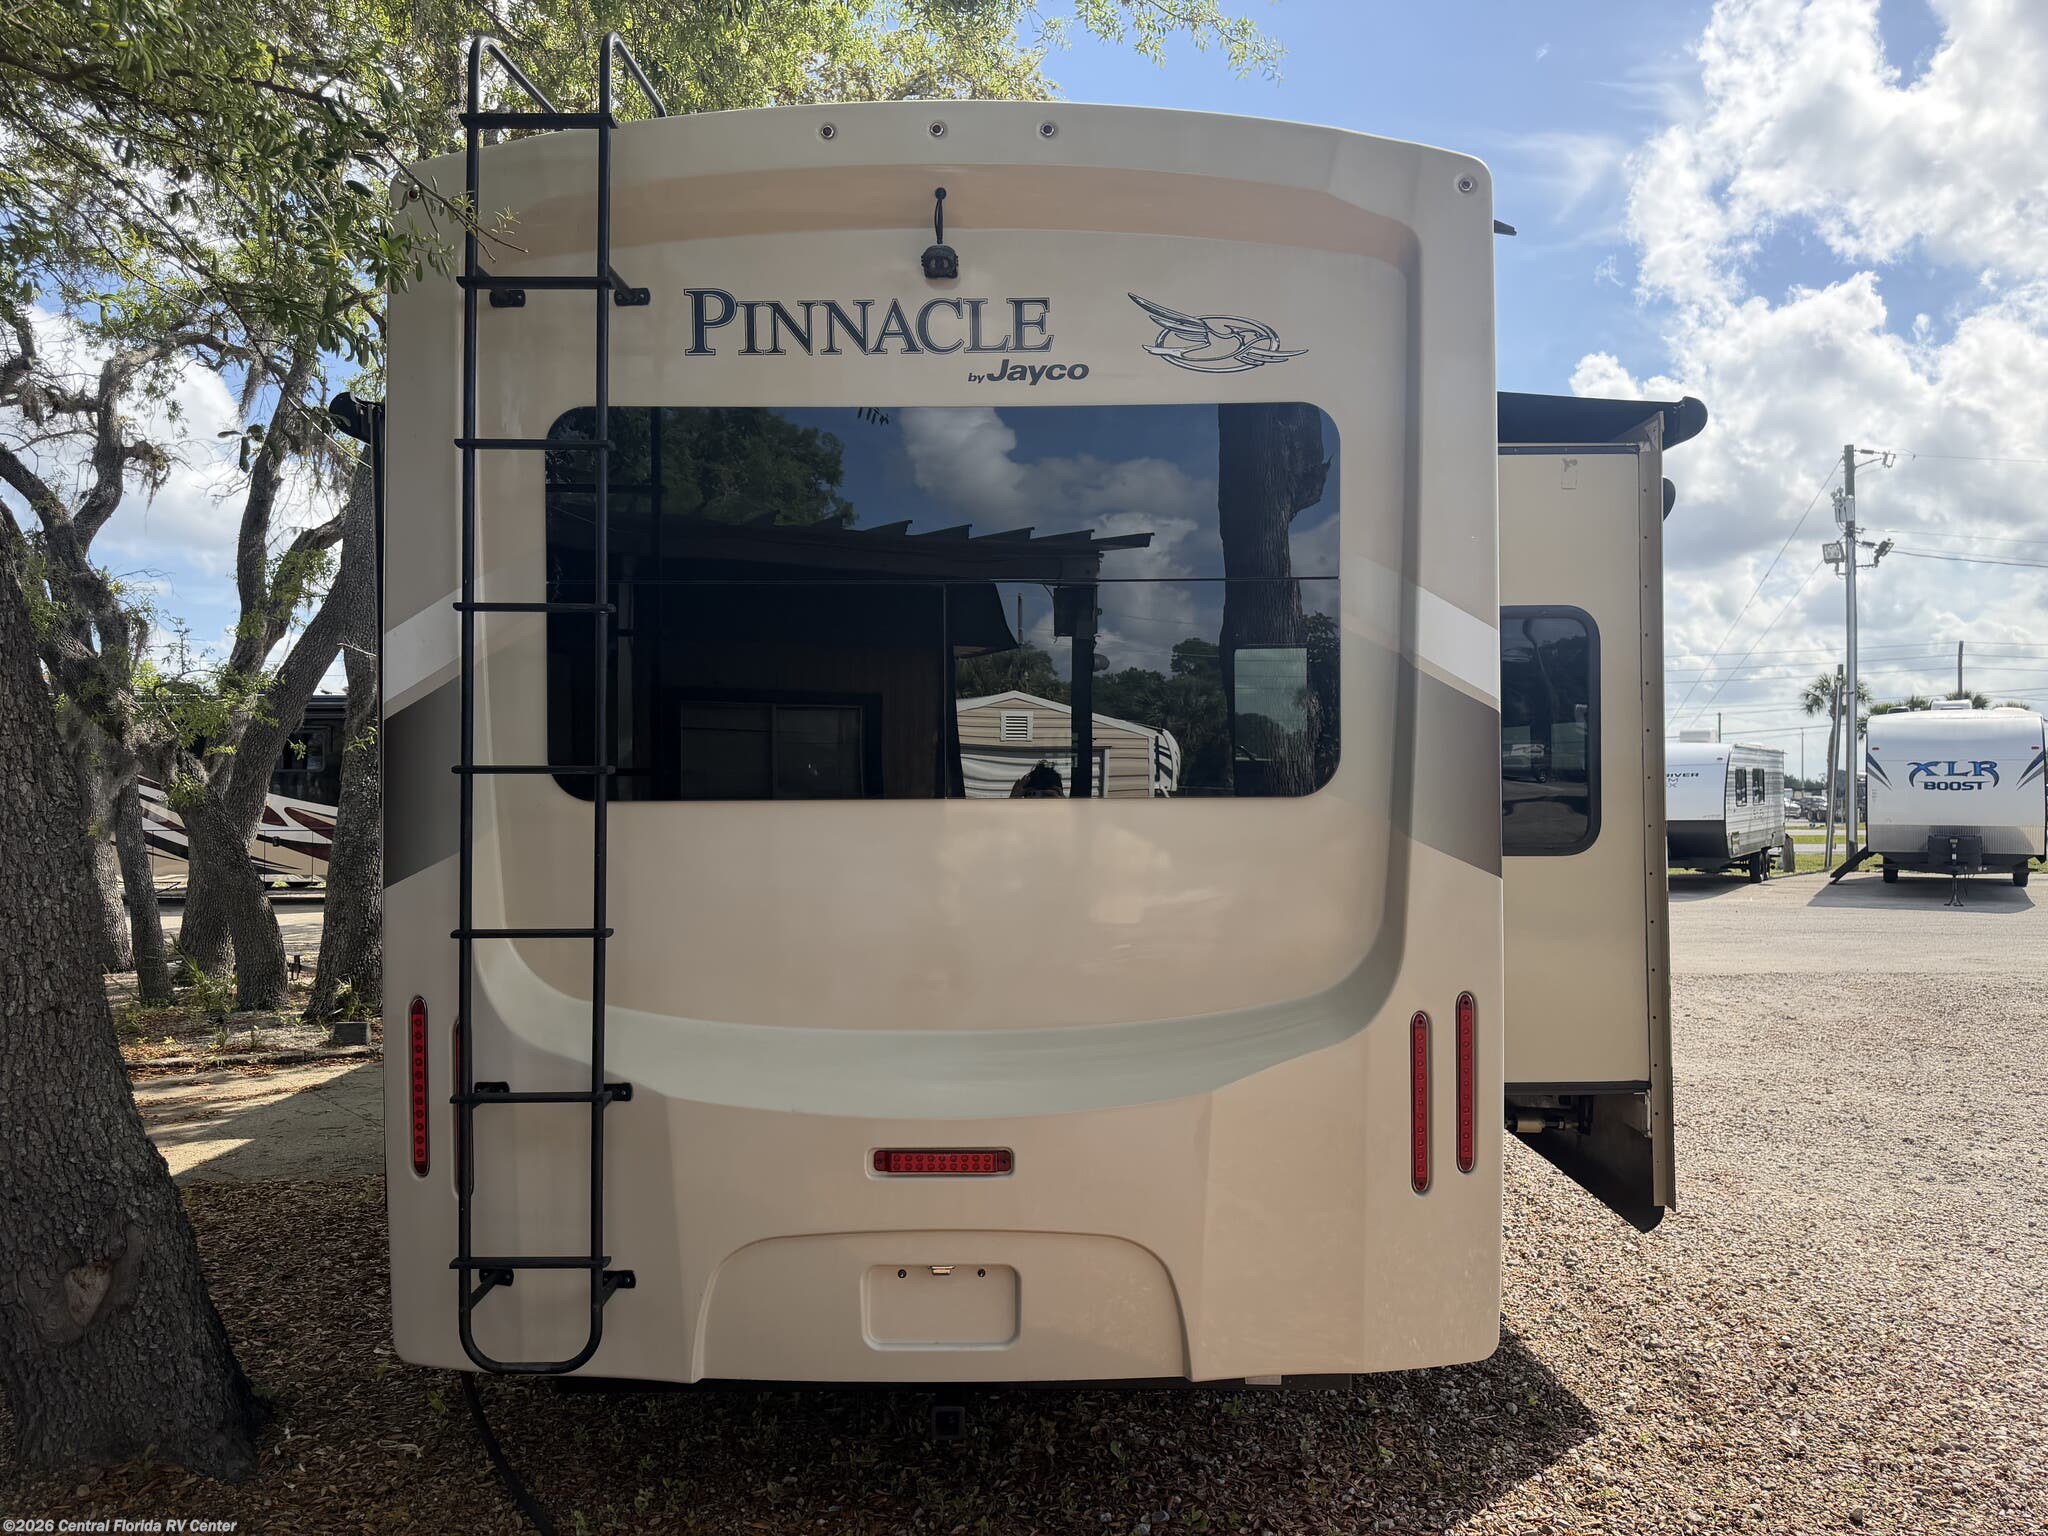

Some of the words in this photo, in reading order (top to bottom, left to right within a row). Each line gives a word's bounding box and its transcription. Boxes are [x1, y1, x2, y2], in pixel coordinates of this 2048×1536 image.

[684, 288, 1055, 356] PINNACLE
[968, 373, 986, 384] by
[987, 359, 1090, 385] Jayco
[1907, 760, 2000, 788] XLR
[1922, 781, 1987, 791] BOOST
